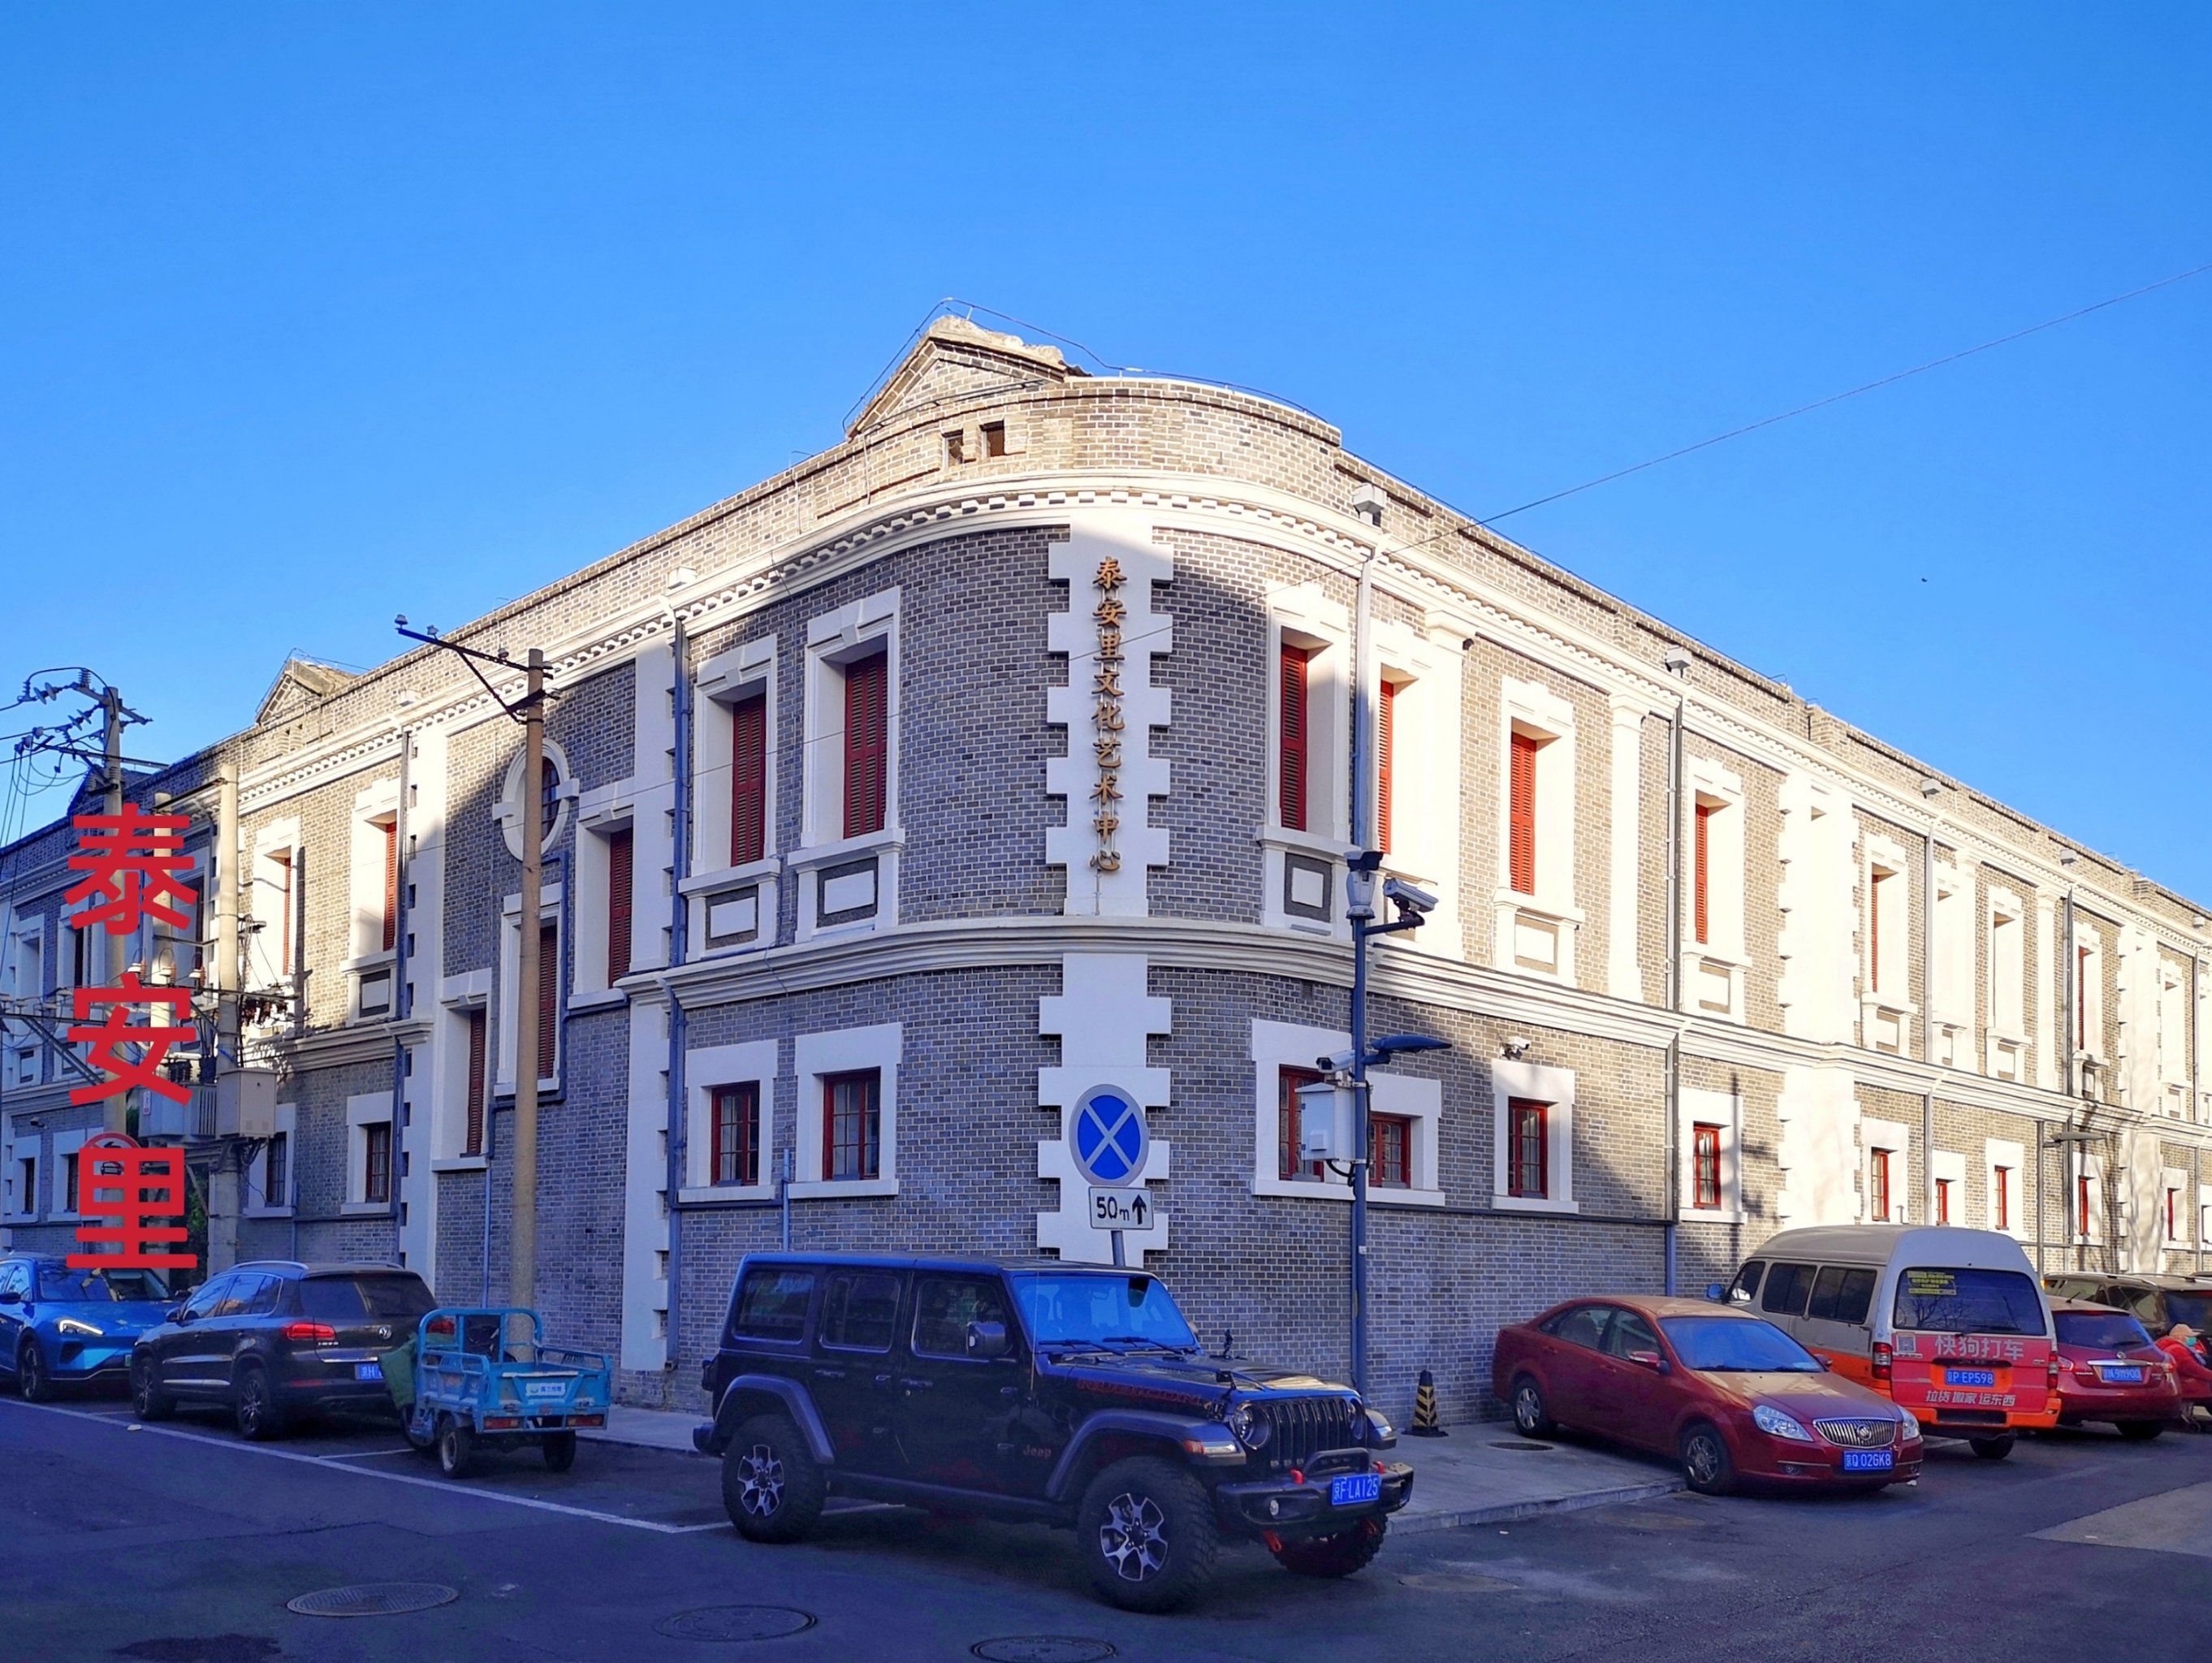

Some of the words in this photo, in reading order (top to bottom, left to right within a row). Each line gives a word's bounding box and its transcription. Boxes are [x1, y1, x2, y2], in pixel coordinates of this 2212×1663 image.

[1090, 556, 1127, 872] 泰安里文化艺术中心
[1096, 1196, 1130, 1221] 50m
[1934, 1336, 2024, 1360] 快狗打车
[1925, 1391, 1949, 1402] 拉货
[1952, 1392, 1977, 1405] 搬家
[1979, 1393, 2016, 1406] 运东西
[1022, 1445, 1052, 1458] Jeep
